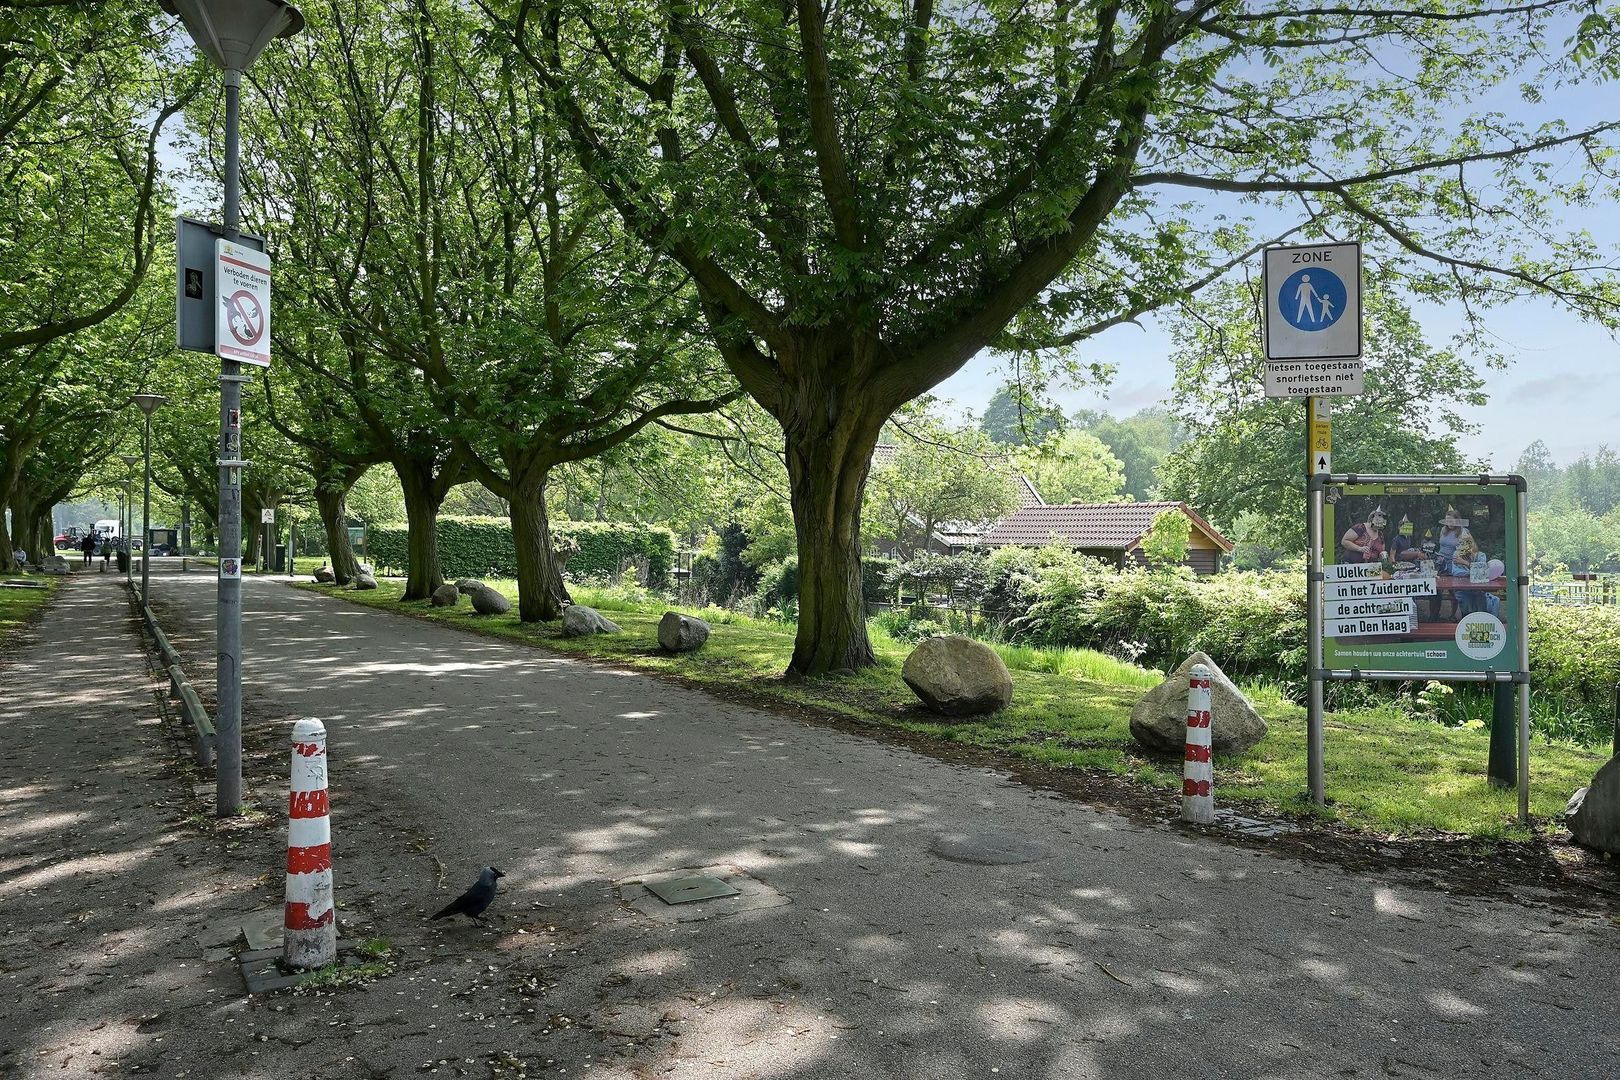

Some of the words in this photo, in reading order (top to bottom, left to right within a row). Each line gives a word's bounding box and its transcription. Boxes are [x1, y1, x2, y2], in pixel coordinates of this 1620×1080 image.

[1292, 251, 1333, 264] ZONE
[224, 266, 249, 280] Verboden
[250, 274, 267, 286] dieren
[234, 278, 239, 286] te
[240, 281, 258, 290] voeren
[1268, 364, 1301, 372] fietsen
[1276, 374, 1331, 383] snorfietsen
[1336, 372, 1354, 381] niet
[1288, 385, 1342, 395] toegestaan
[1336, 566, 1378, 578] Welk
[1338, 586, 1348, 597] in
[1350, 584, 1368, 596] het
[1370, 581, 1434, 596] Zuiderpark,
[1338, 604, 1350, 615] de
[1338, 623, 1356, 634] van
[1360, 620, 1379, 632] Den
[1382, 620, 1407, 632] Haag
[1426, 650, 1446, 658] schoon
